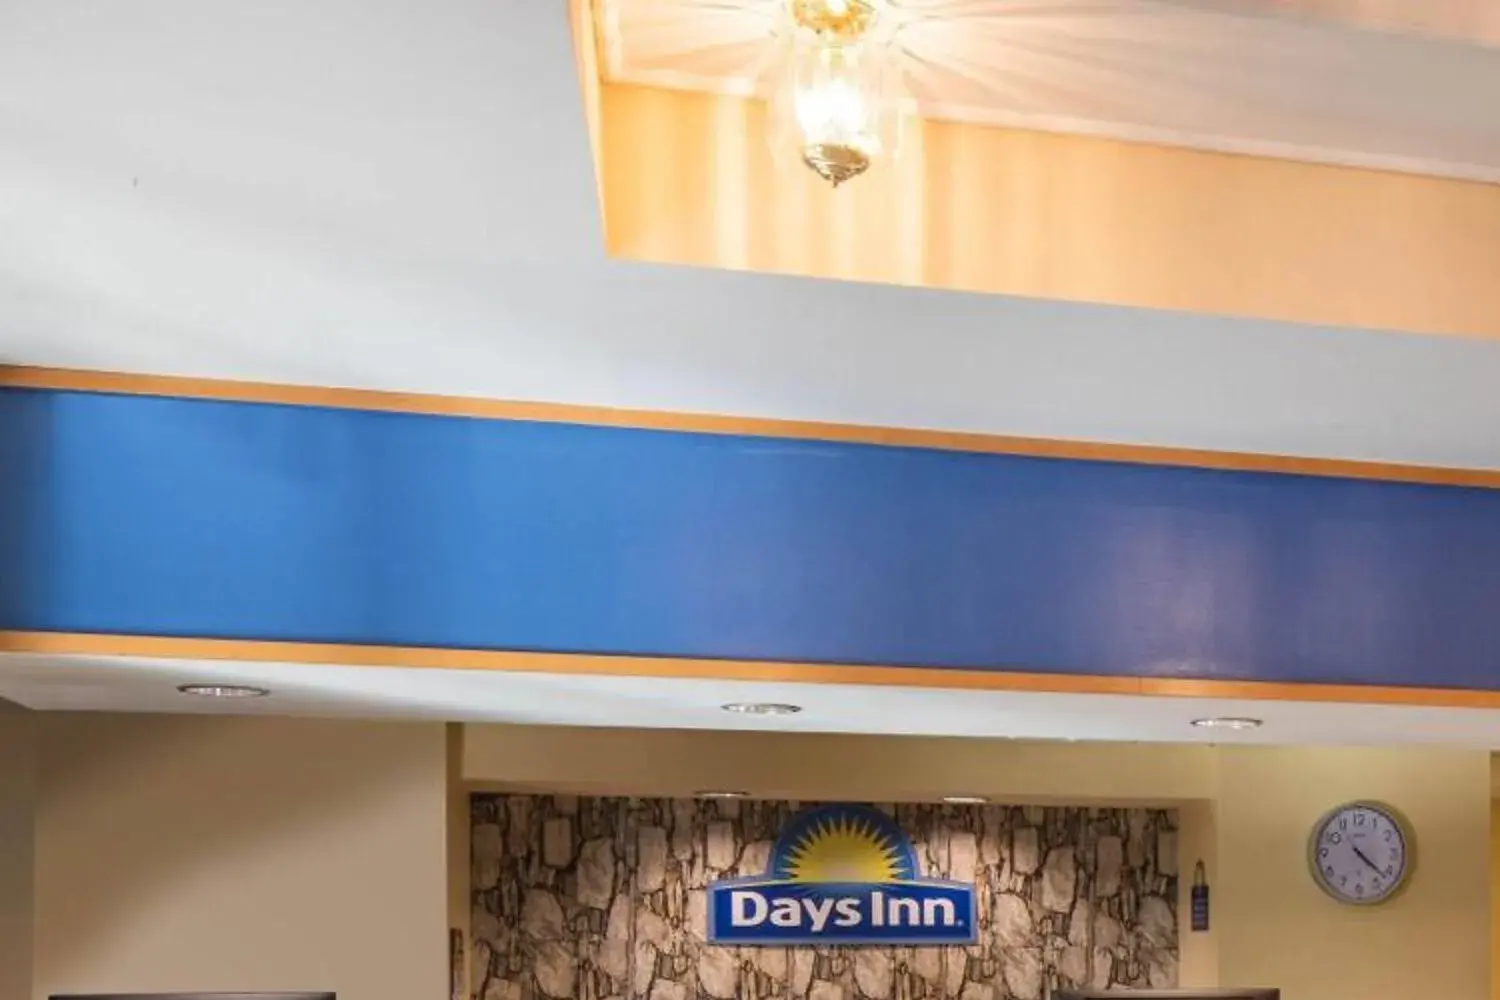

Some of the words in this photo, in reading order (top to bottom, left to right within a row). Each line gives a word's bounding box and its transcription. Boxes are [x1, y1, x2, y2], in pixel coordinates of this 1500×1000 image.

[1353, 813, 1365, 826] 12
[731, 891, 862, 932] Days
[871, 891, 955, 926] Inn
